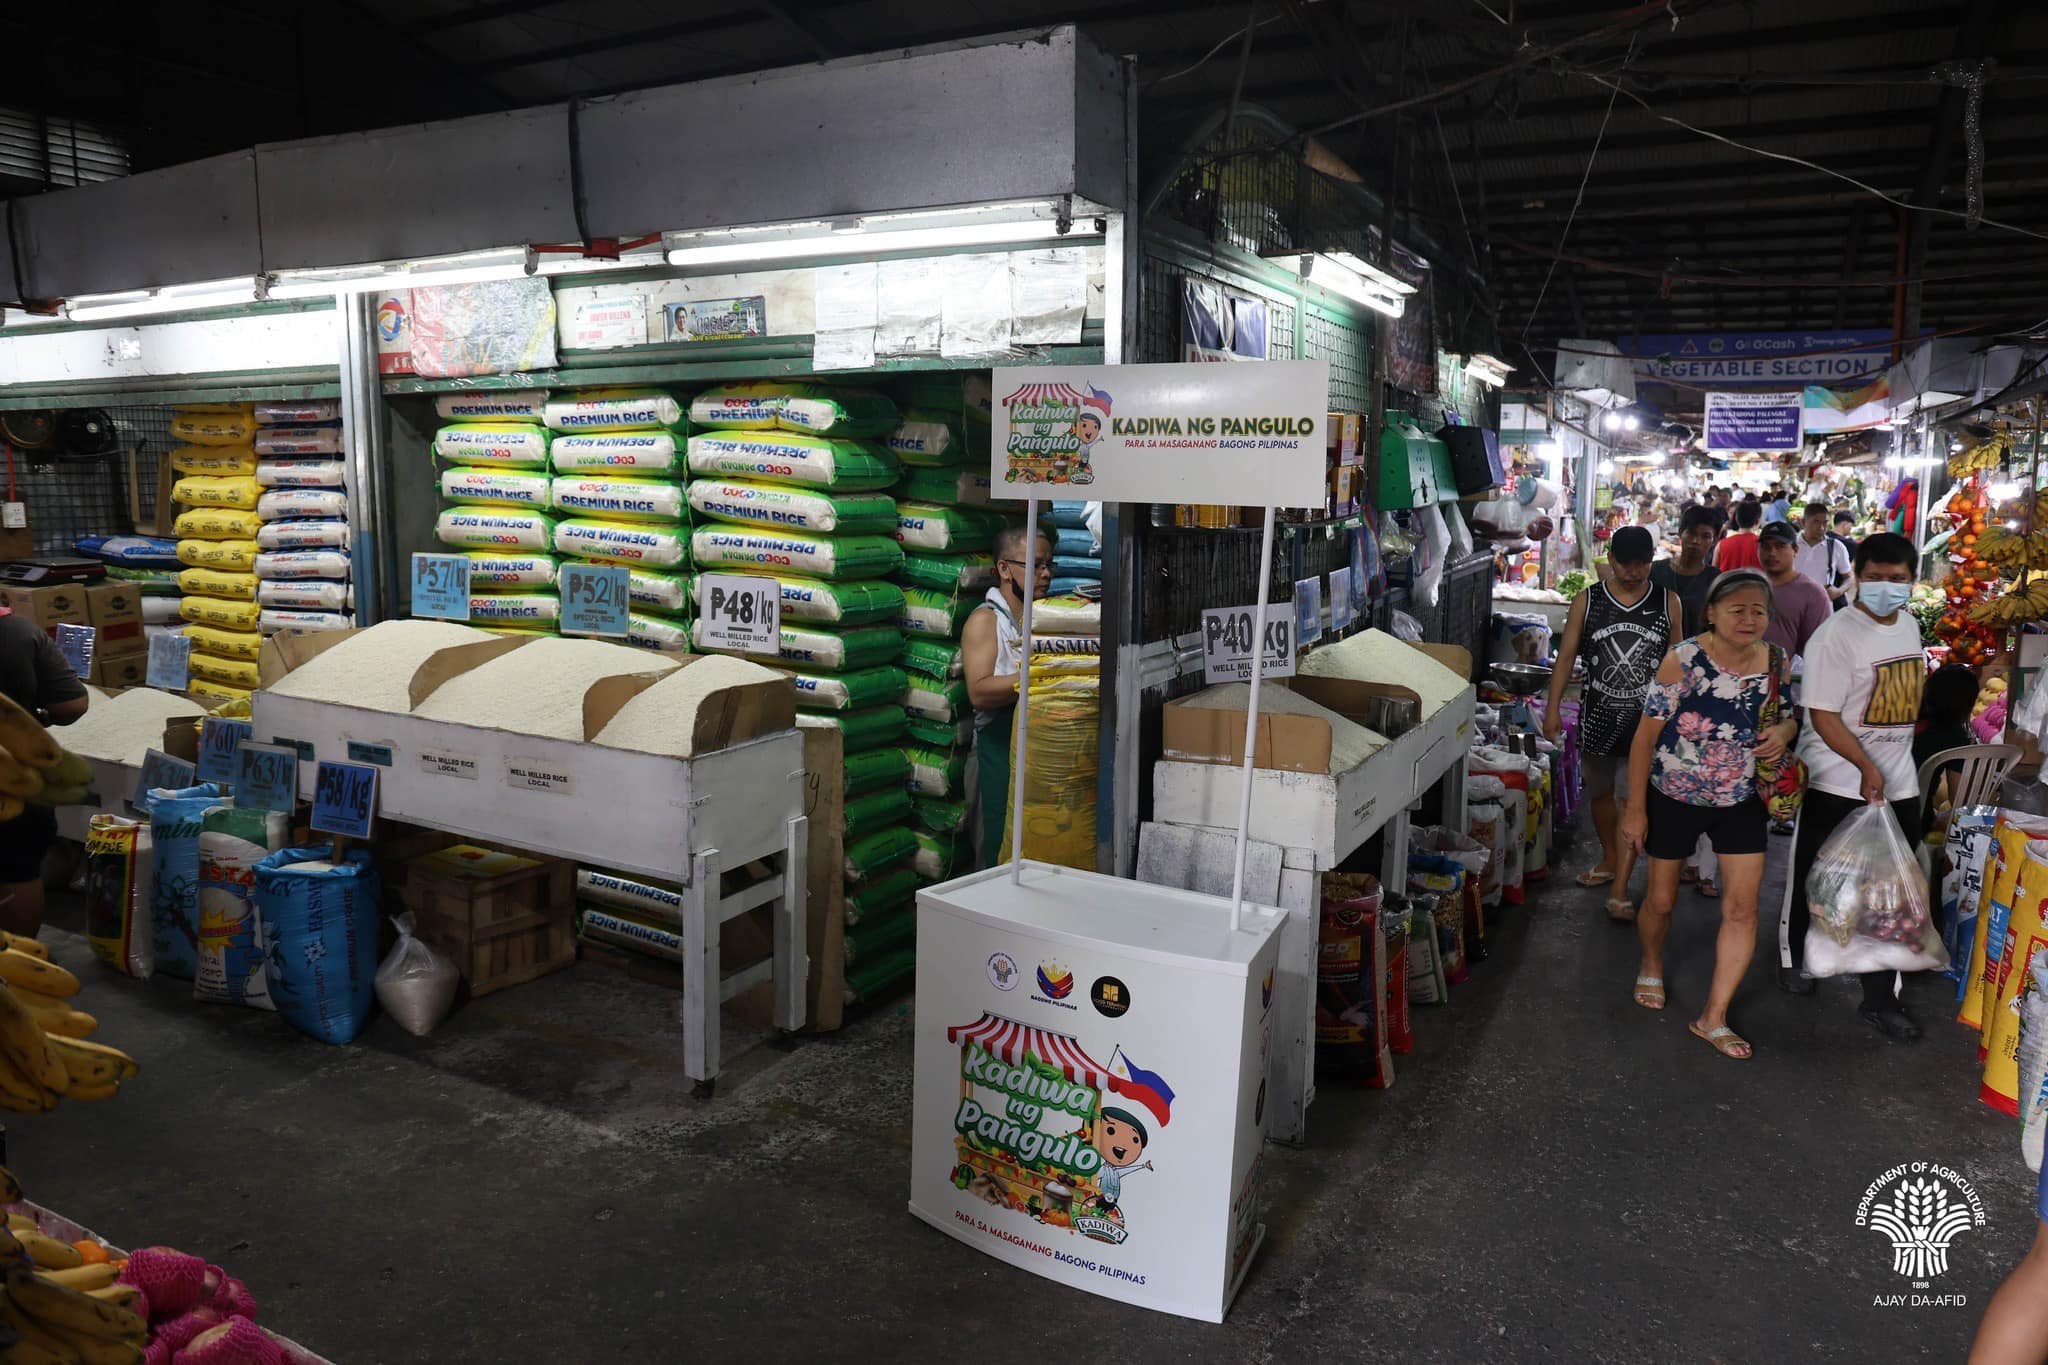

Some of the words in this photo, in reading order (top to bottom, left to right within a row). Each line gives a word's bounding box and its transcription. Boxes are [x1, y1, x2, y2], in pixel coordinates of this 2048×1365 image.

[1753, 338, 1795, 350] GCash
[1647, 358, 1763, 377] VEGETABLE
[1772, 358, 1868, 375] SECTION
[452, 404, 504, 416] PREMIUM
[504, 404, 532, 416] RICE
[710, 408, 778, 420] PREMIUM
[1011, 404, 1077, 420] Kadiwa
[560, 415, 621, 426] PREMIUM
[624, 411, 656, 422] RICE
[1033, 422, 1053, 436] ng
[1112, 417, 1182, 436] KADIWA
[1187, 418, 1214, 436] NG
[1221, 417, 1314, 437] PANGULO
[445, 432, 472, 442] RICE
[564, 438, 594, 448] RICE
[596, 438, 656, 448] PREMIUM
[738, 441, 810, 458] PREMIUM
[890, 438, 924, 450] RICE
[1008, 434, 1081, 454] Pangulo
[1124, 439, 1146, 448] PARA
[1147, 440, 1158, 448] SA
[1159, 439, 1218, 449] MASAGANANG
[1219, 439, 1256, 449] BAGONG
[1258, 439, 1299, 449] PILIPINAS
[485, 449, 510, 458] COCO
[606, 456, 636, 465] COCO
[757, 464, 792, 476] COCO
[450, 486, 504, 499] PREMIUM
[505, 490, 534, 500] RICE
[722, 487, 756, 498] COCO
[561, 496, 620, 510] PREMIUM
[622, 500, 656, 512] RICE
[704, 502, 769, 522] PREMIUM
[771, 512, 808, 526] RICE
[451, 516, 478, 526] RICE
[480, 518, 532, 528] PREMIUM
[565, 526, 596, 538] RICE
[598, 530, 658, 546] PREMIUM
[493, 535, 518, 544] COCO
[710, 534, 744, 546] RICE
[747, 538, 816, 554] PREMIUM
[611, 548, 642, 558] COCO
[484, 560, 533, 571] PREMIUM
[756, 554, 790, 566] COCO
[492, 574, 520, 582] COCO
[471, 608, 510, 618] EMIUM
[511, 608, 538, 616] RICE
[1606, 624, 1620, 634] THE
[1622, 624, 1648, 635] TAILOR
[710, 631, 728, 639] WELL
[728, 632, 752, 641] MILLED
[752, 634, 768, 642] RICE
[1206, 612, 1289, 660] ₱40kg
[728, 640, 750, 648] LOCAL
[780, 649, 814, 662] RICE
[1213, 664, 1236, 672] WELL
[1238, 662, 1268, 670] MILD
[1270, 660, 1288, 668] RICE
[422, 754, 438, 762] WELL
[440, 757, 459, 767] MILLED
[460, 760, 474, 768] RICE
[438, 765, 458, 773] LOCAL
[510, 768, 526, 777] WELL
[528, 770, 551, 780] MILLED
[552, 774, 568, 783] RICE
[528, 778, 550, 788] LOCAL
[589, 874, 620, 890] RICE
[622, 883, 682, 907] PREMIUM
[588, 914, 617, 930] RICE
[618, 925, 680, 949] PREMIUM
[1030, 994, 1052, 1006] BAGONG
[1052, 1000, 1078, 1012] PILIPINAS
[964, 1046, 1094, 1114] Kadiwa
[1006, 1095, 1040, 1124] ng
[958, 1100, 1099, 1172] Pangulo
[1080, 1217, 1123, 1240] KADIWA
[956, 1210, 976, 1228] PARA
[976, 1220, 988, 1232] SA
[990, 1224, 1052, 1258] MASAGANANG
[1054, 1250, 1097, 1272] BAGONG
[1098, 1264, 1146, 1286] PILIPINAS
